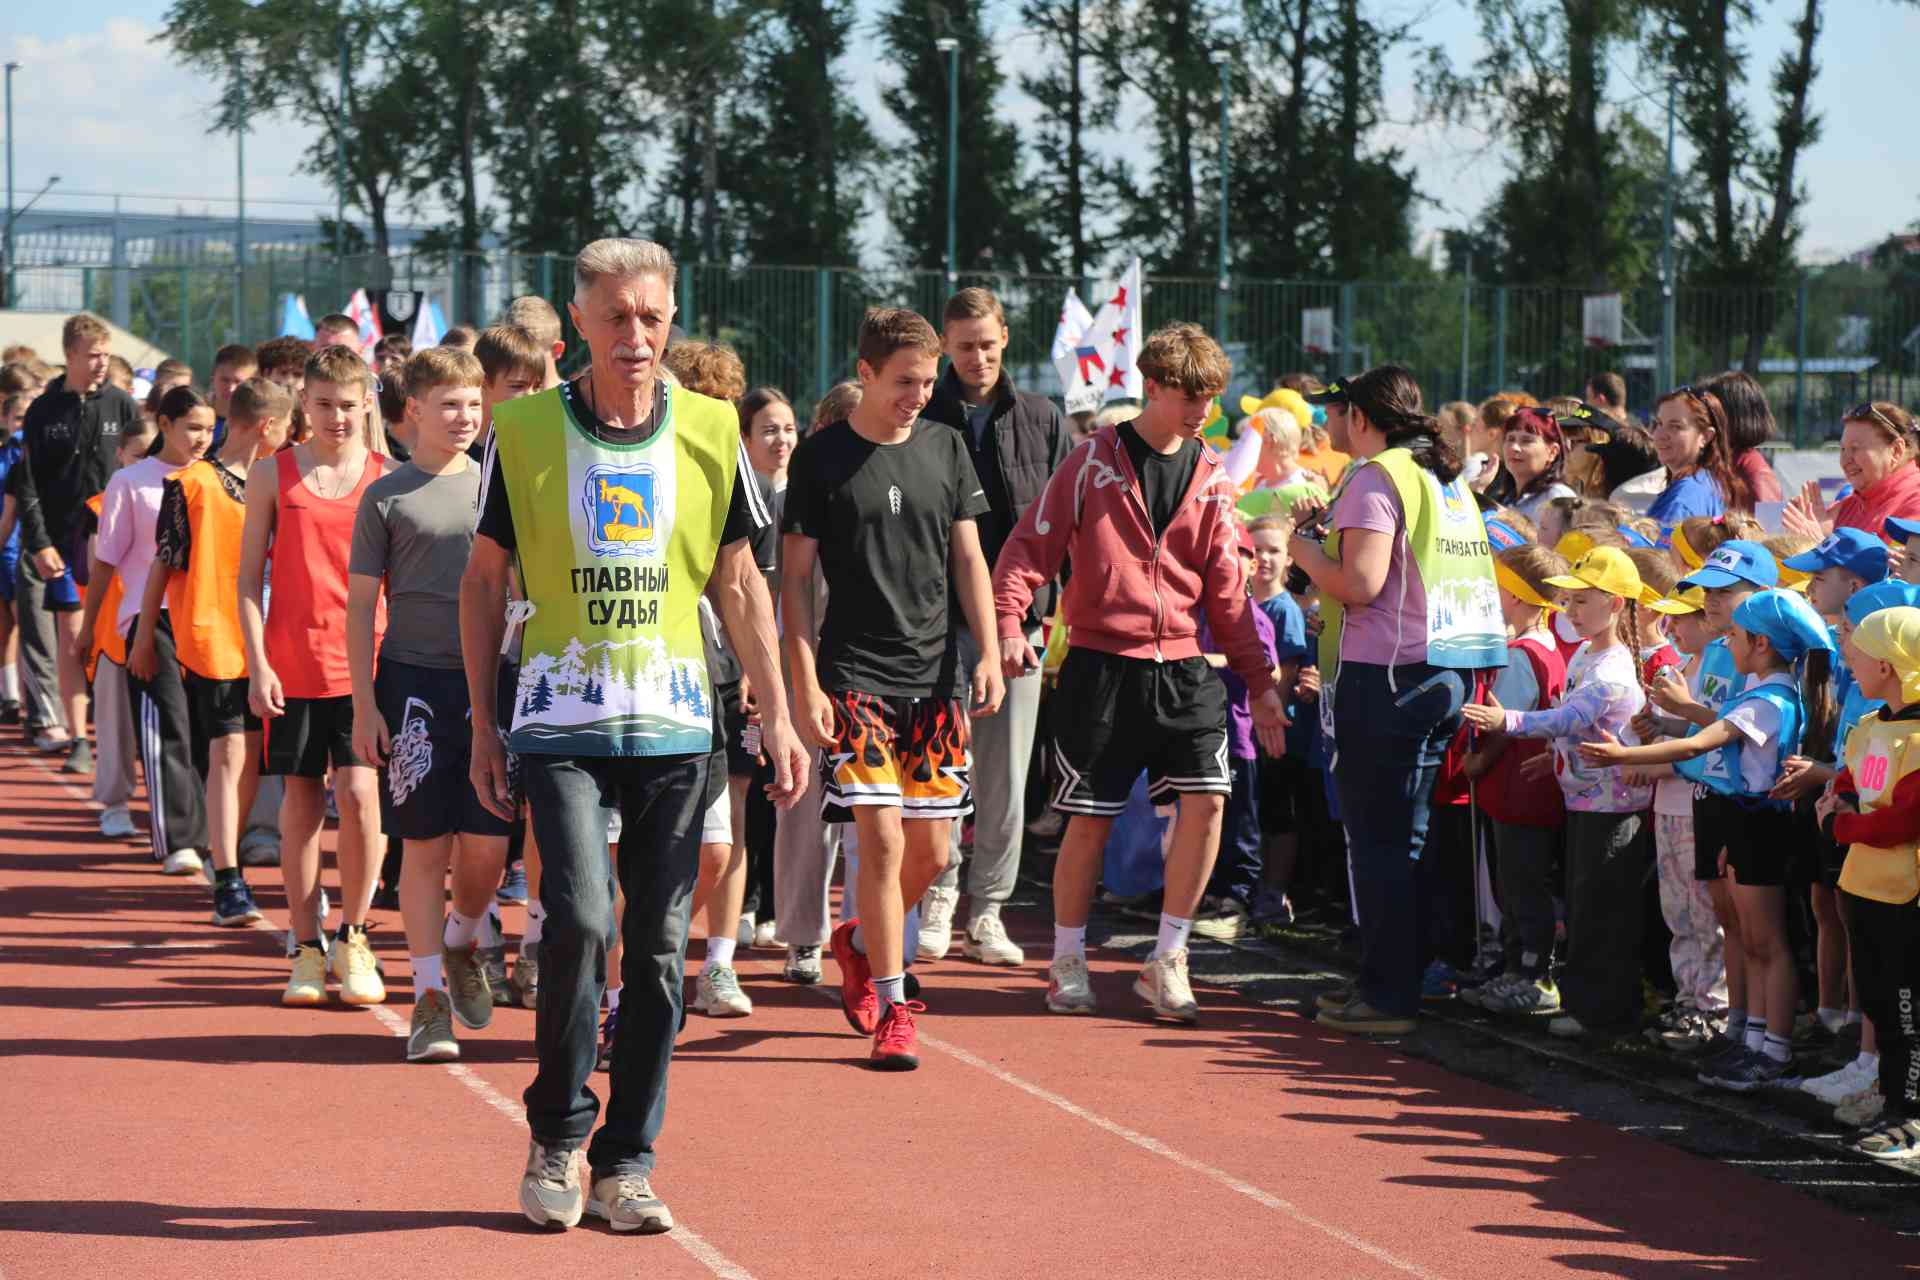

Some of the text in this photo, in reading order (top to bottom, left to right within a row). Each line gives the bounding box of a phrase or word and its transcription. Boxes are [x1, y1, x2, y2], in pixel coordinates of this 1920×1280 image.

[571, 562, 669, 593] ГЛАВНЫЙ
[588, 599, 657, 629] СУДЬЯ
[1899, 988, 1914, 1035] BORN
